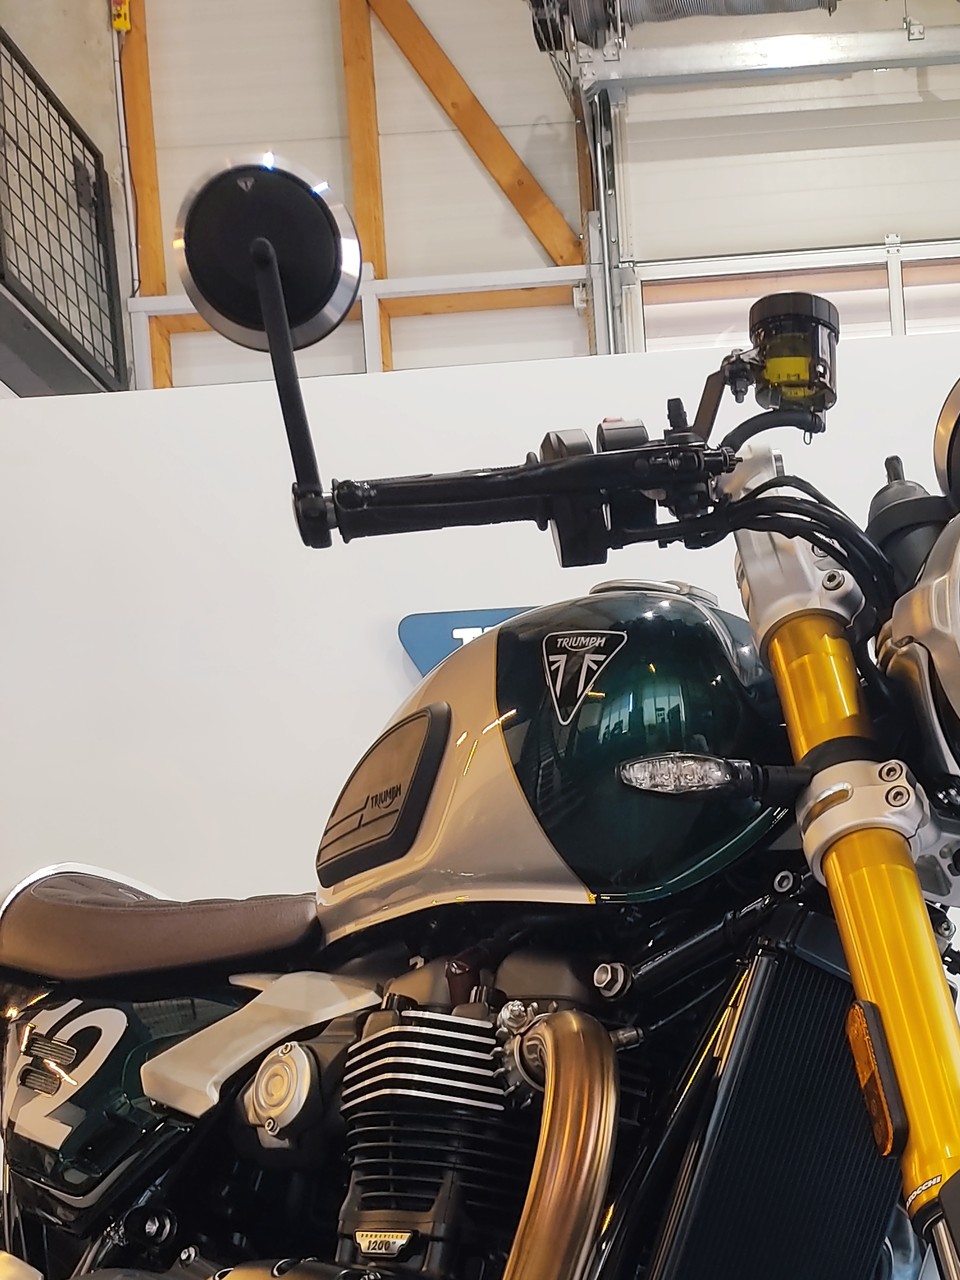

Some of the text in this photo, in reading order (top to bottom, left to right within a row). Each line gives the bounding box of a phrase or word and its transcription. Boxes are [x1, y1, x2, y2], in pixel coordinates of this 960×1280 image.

[556, 636, 607, 652] TRIUMPH
[370, 783, 402, 809] TRIUMPH
[367, 1239, 392, 1252] 1200
